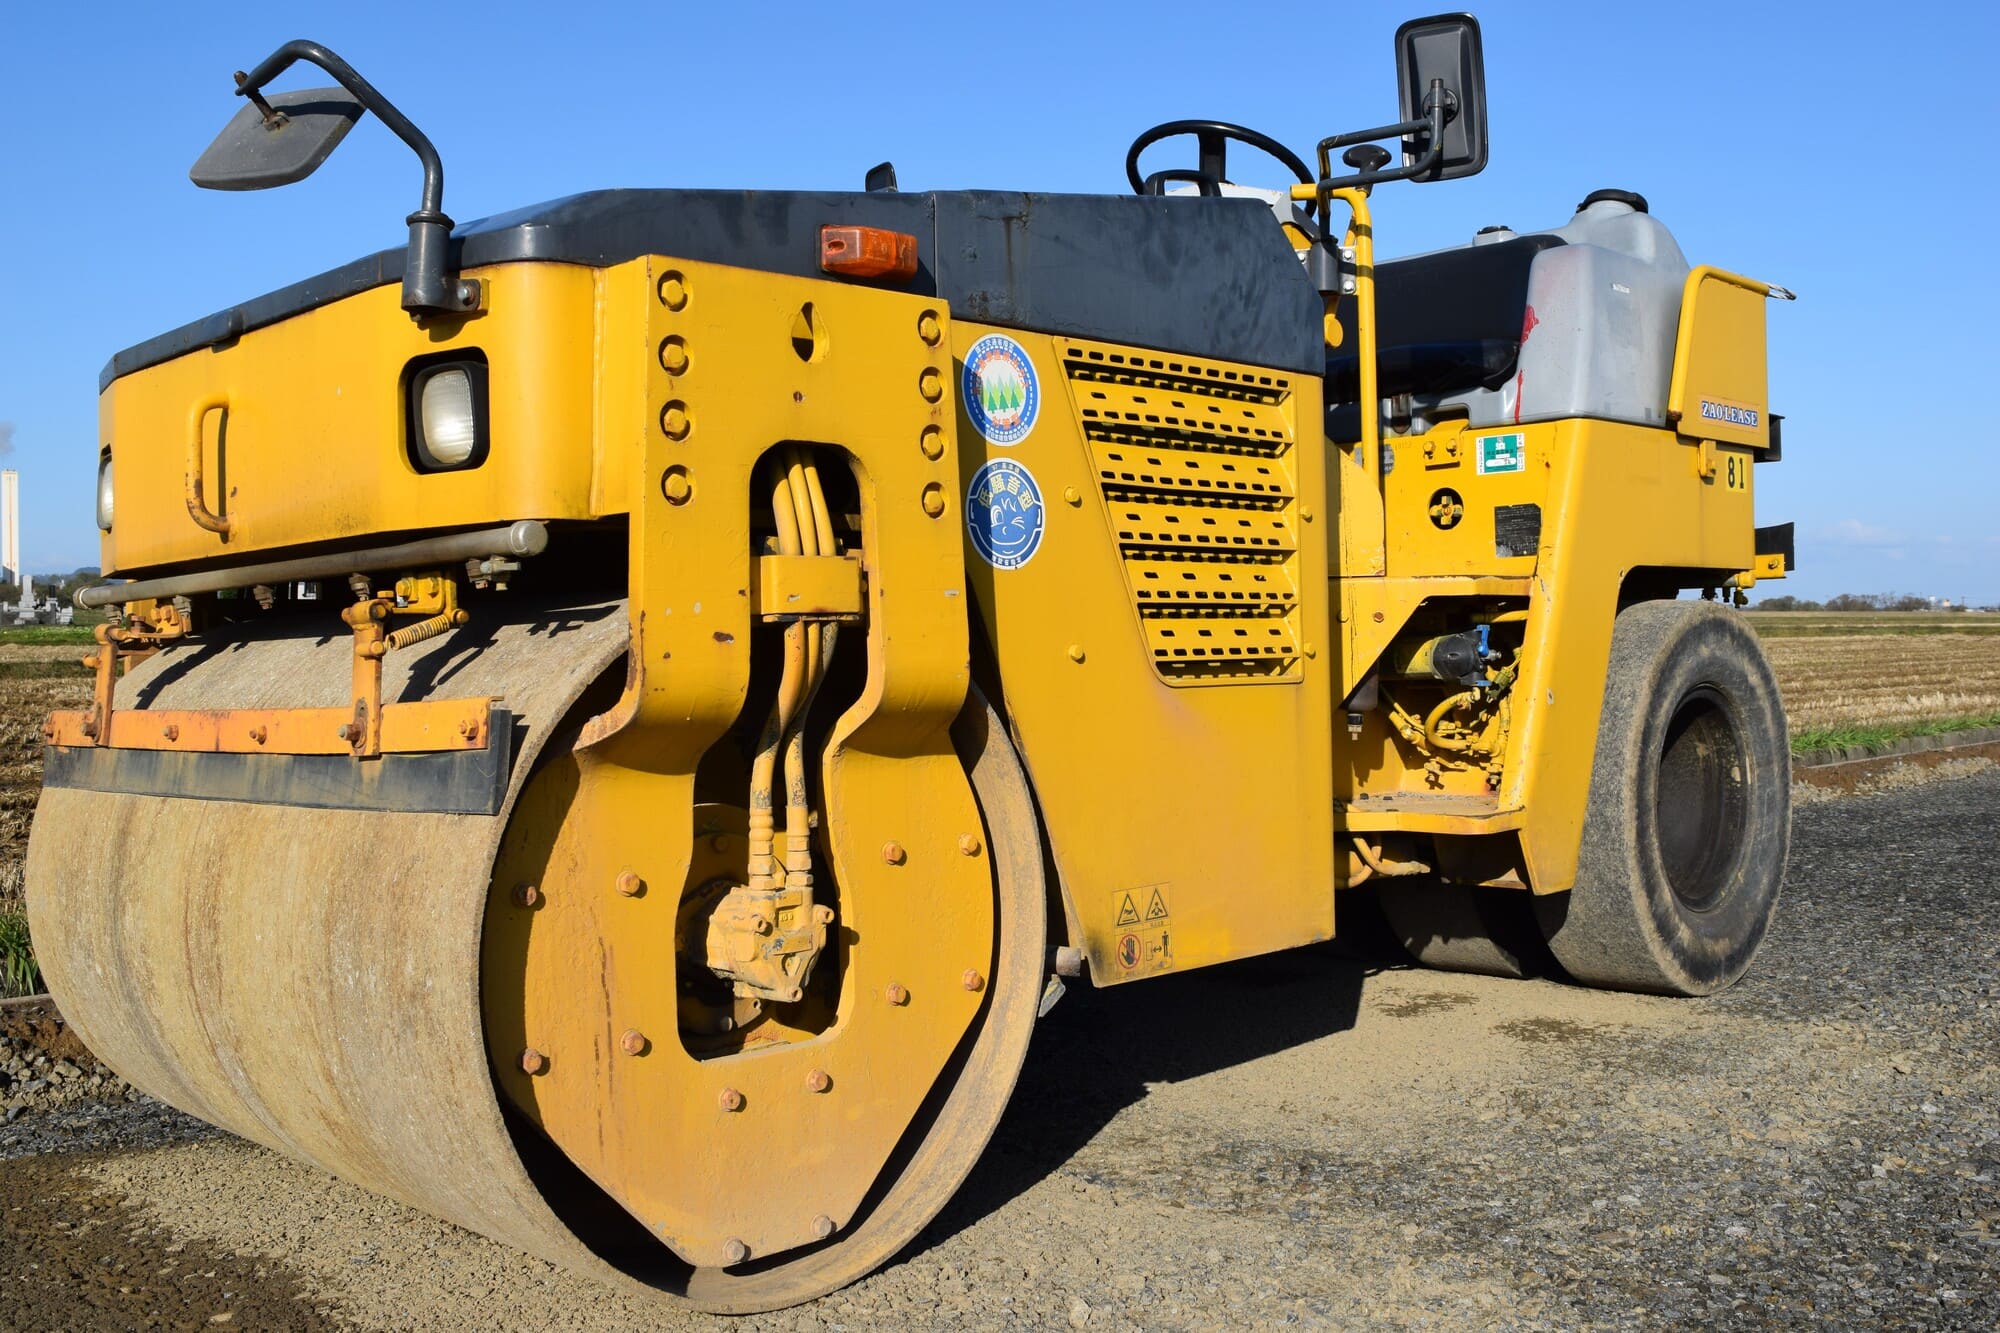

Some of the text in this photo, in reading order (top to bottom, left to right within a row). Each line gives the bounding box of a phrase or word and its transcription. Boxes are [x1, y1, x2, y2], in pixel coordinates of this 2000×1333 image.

[1701, 401, 1758, 427] ZAO LEASE
[1727, 456, 1745, 489] 81
[978, 473, 1034, 512] 低騒音型
